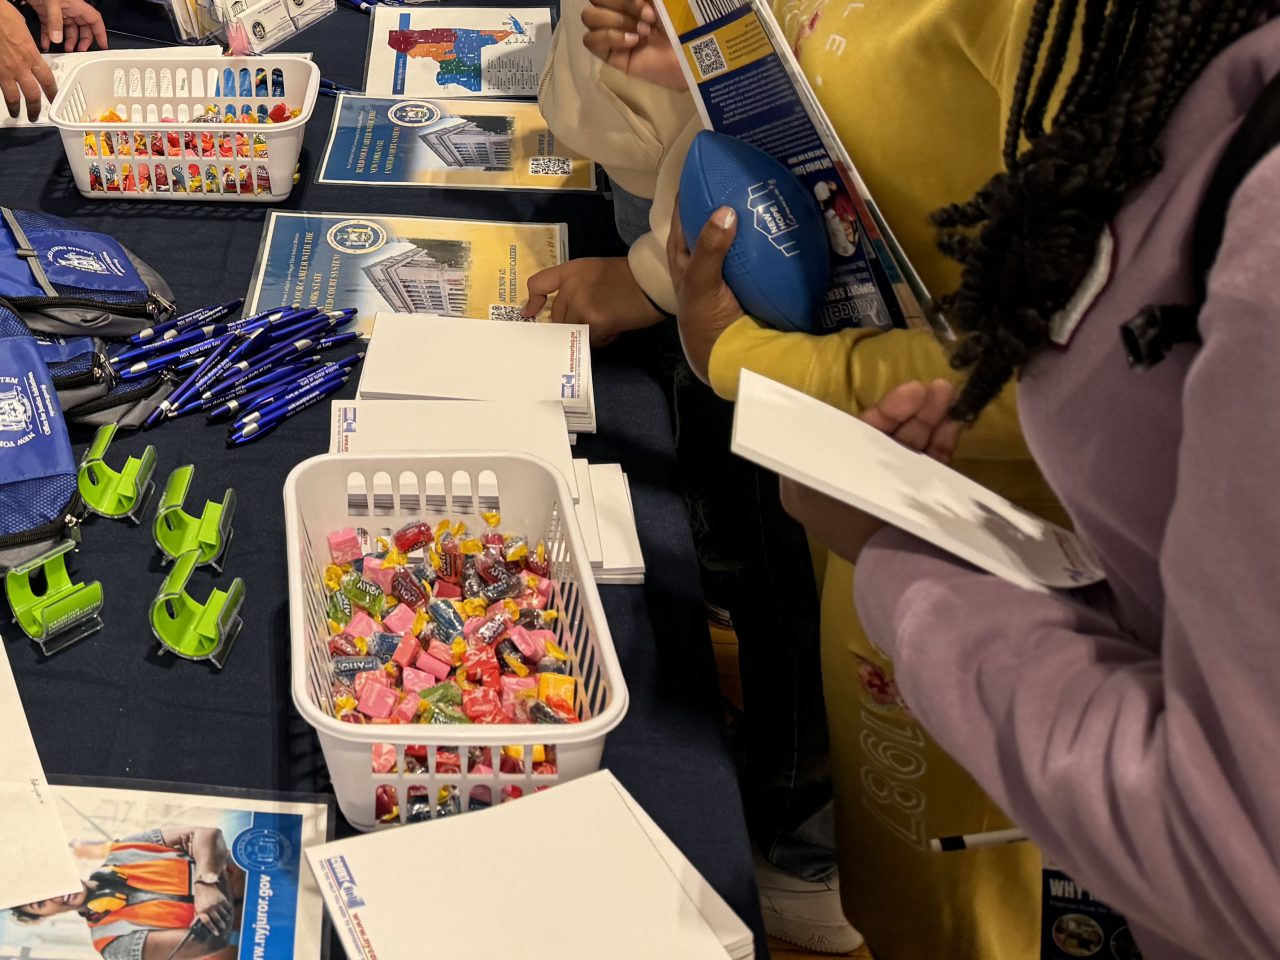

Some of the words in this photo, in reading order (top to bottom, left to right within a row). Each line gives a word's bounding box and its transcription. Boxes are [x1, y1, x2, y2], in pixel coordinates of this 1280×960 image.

[368, 109, 376, 119] THE
[365, 118, 374, 132] WITH
[362, 131, 371, 148] CAREER
[375, 138, 383, 151] STATE
[359, 147, 367, 159] YOUR
[372, 150, 381, 163] YORK
[355, 158, 365, 173] BUILD
[369, 162, 378, 174] NEW
[763, 211, 777, 234] NEW
[770, 204, 786, 229] HOPE
[304, 231, 313, 243] THE
[301, 243, 311, 260] WITH
[297, 260, 307, 285] CAREER
[330, 253, 340, 278] SYSTEM
[312, 271, 321, 290] STATE
[326, 278, 336, 298] COURT
[498, 275, 506, 287] NOW
[294, 284, 303, 302] YOUR
[309, 289, 319, 308] YORK
[498, 287, 506, 302] APPLY
[17, 431, 35, 445] NEW
[357, 579, 383, 597] JOLLY
[331, 856, 348, 884] COURT
[250, 873, 272, 960] w.nyjuror.gov
[351, 912, 375, 960] www.nyco
